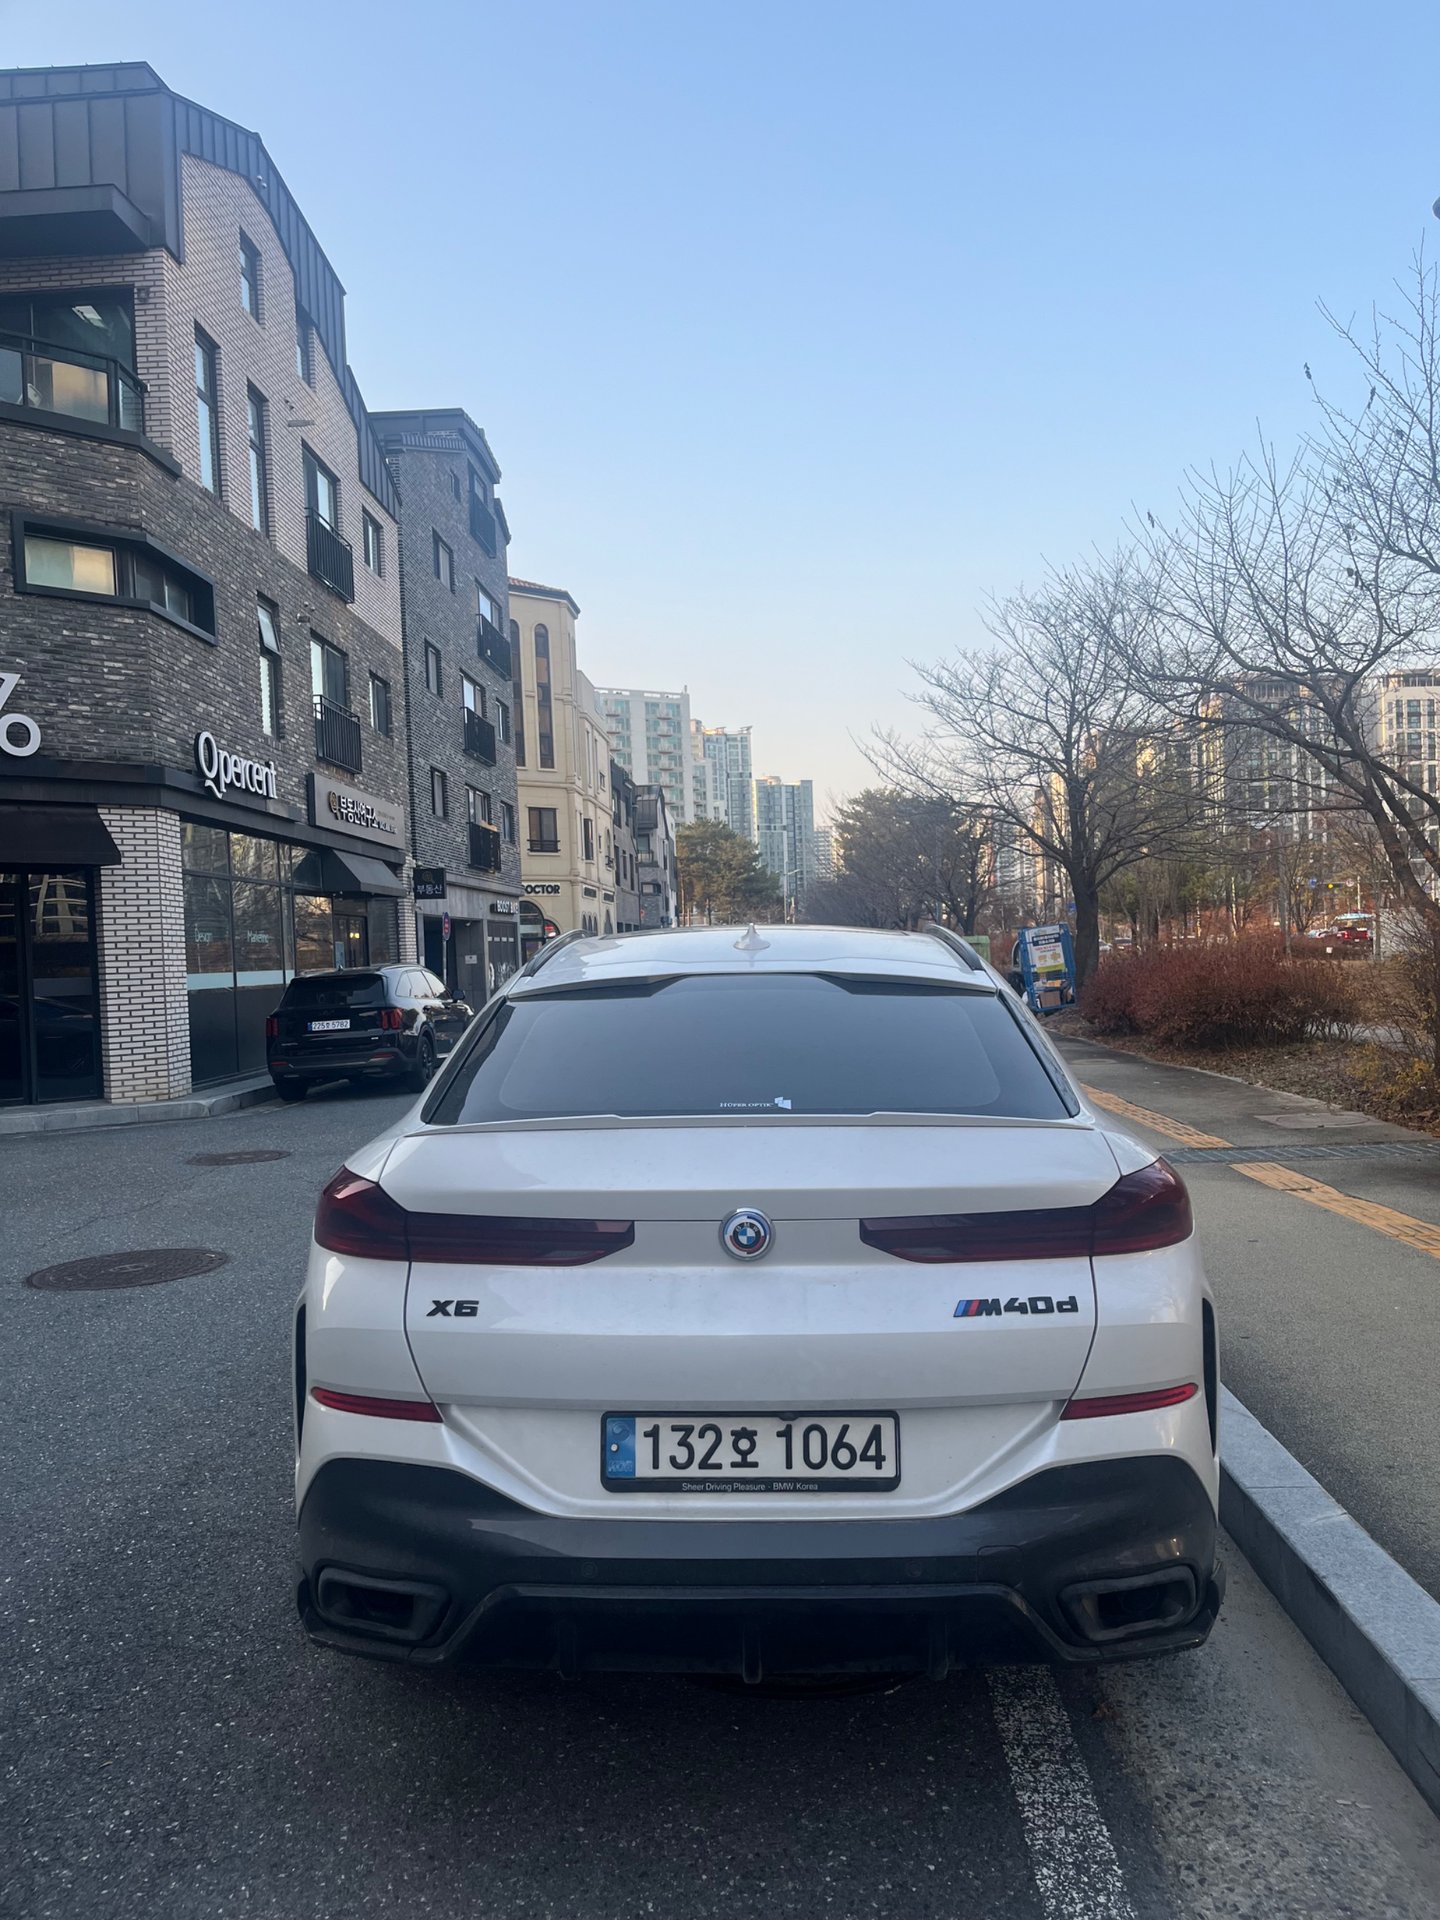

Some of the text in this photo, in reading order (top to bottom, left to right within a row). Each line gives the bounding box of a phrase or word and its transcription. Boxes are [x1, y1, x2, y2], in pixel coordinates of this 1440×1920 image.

[198, 731, 278, 799] Qpercent
[416, 884, 443, 895] 부동산
[521, 884, 560, 895] OCTOR
[426, 1299, 479, 1317] X6
[977, 1295, 1079, 1316] M40d
[643, 1423, 886, 1470] 132호 1064
[682, 1482, 818, 1492] Sheer Driving Pleasure BMW Korea
